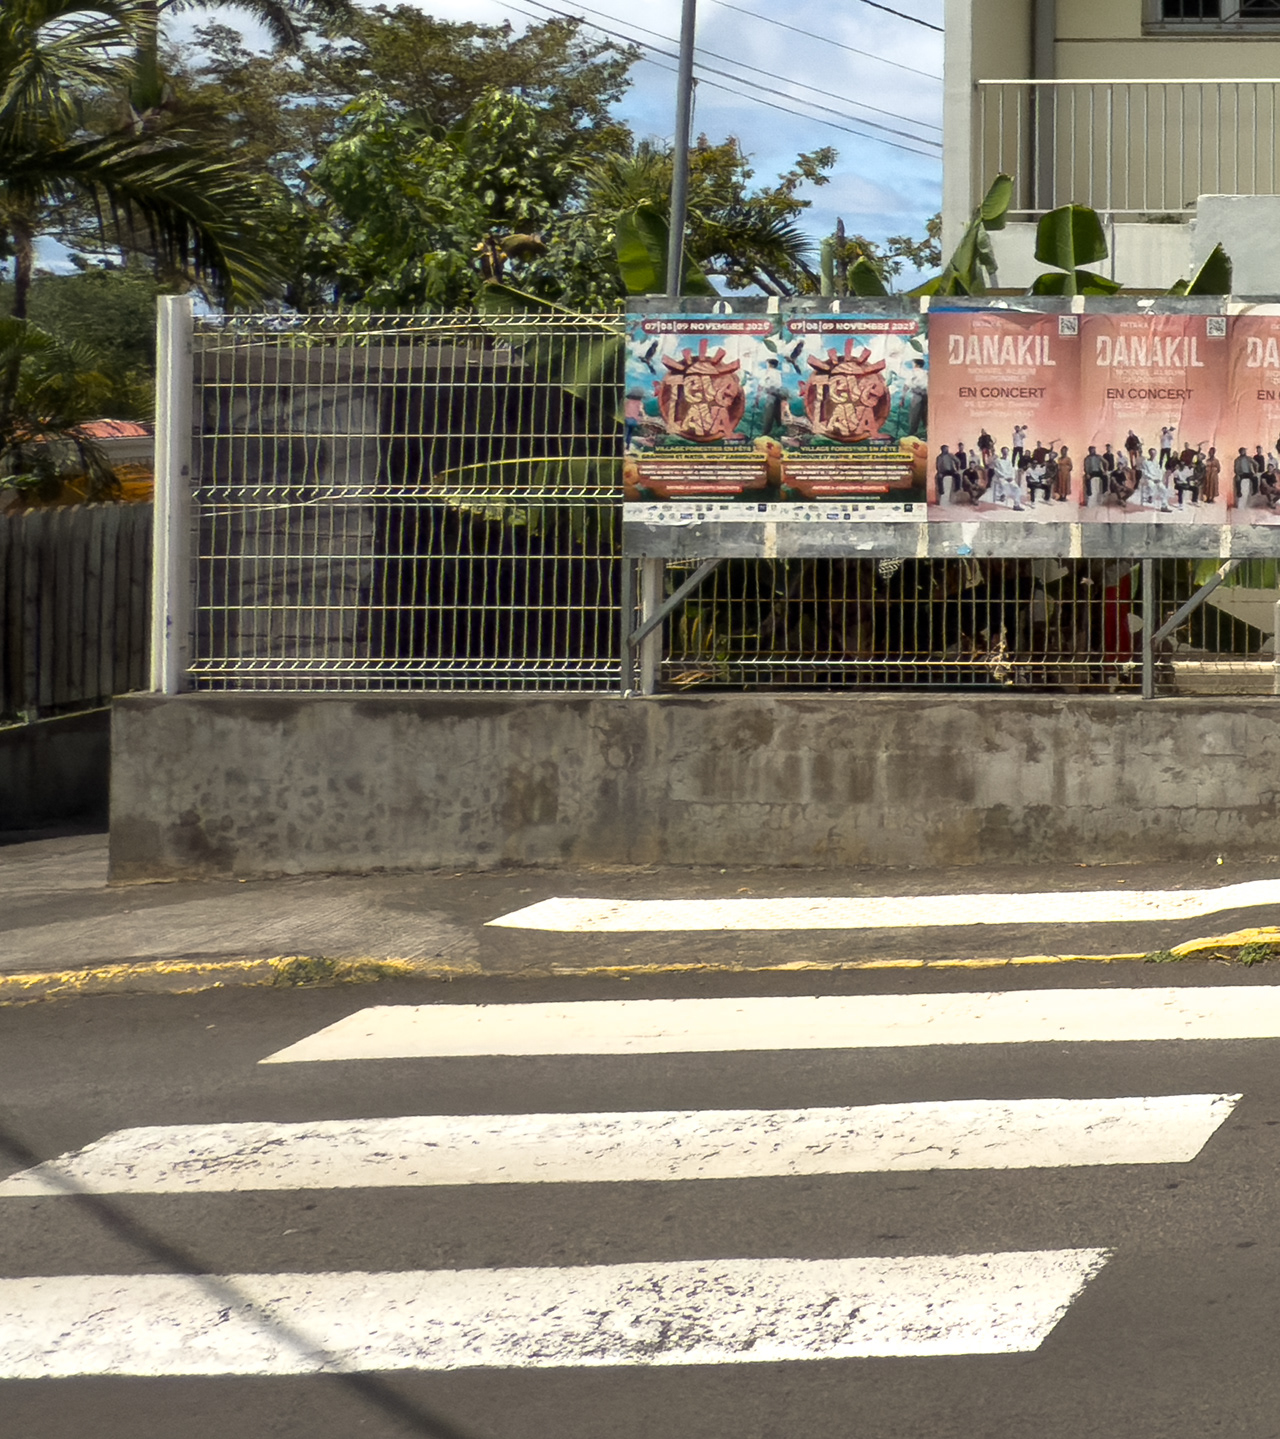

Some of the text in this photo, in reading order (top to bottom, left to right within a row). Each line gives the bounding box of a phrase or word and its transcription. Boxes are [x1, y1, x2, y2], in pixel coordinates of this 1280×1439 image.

[690, 323, 744, 331] NOVEMBRE
[746, 322, 770, 331] 2025
[836, 323, 889, 331] NOVEMBRE
[892, 322, 916, 330] 2025
[948, 334, 1057, 366] DANAKIL
[1096, 336, 1205, 367] DANAKIL
[959, 387, 1046, 398] EN CONCERT
[1107, 388, 1194, 399] EN CONCERT
[1257, 390, 1275, 400] EN
